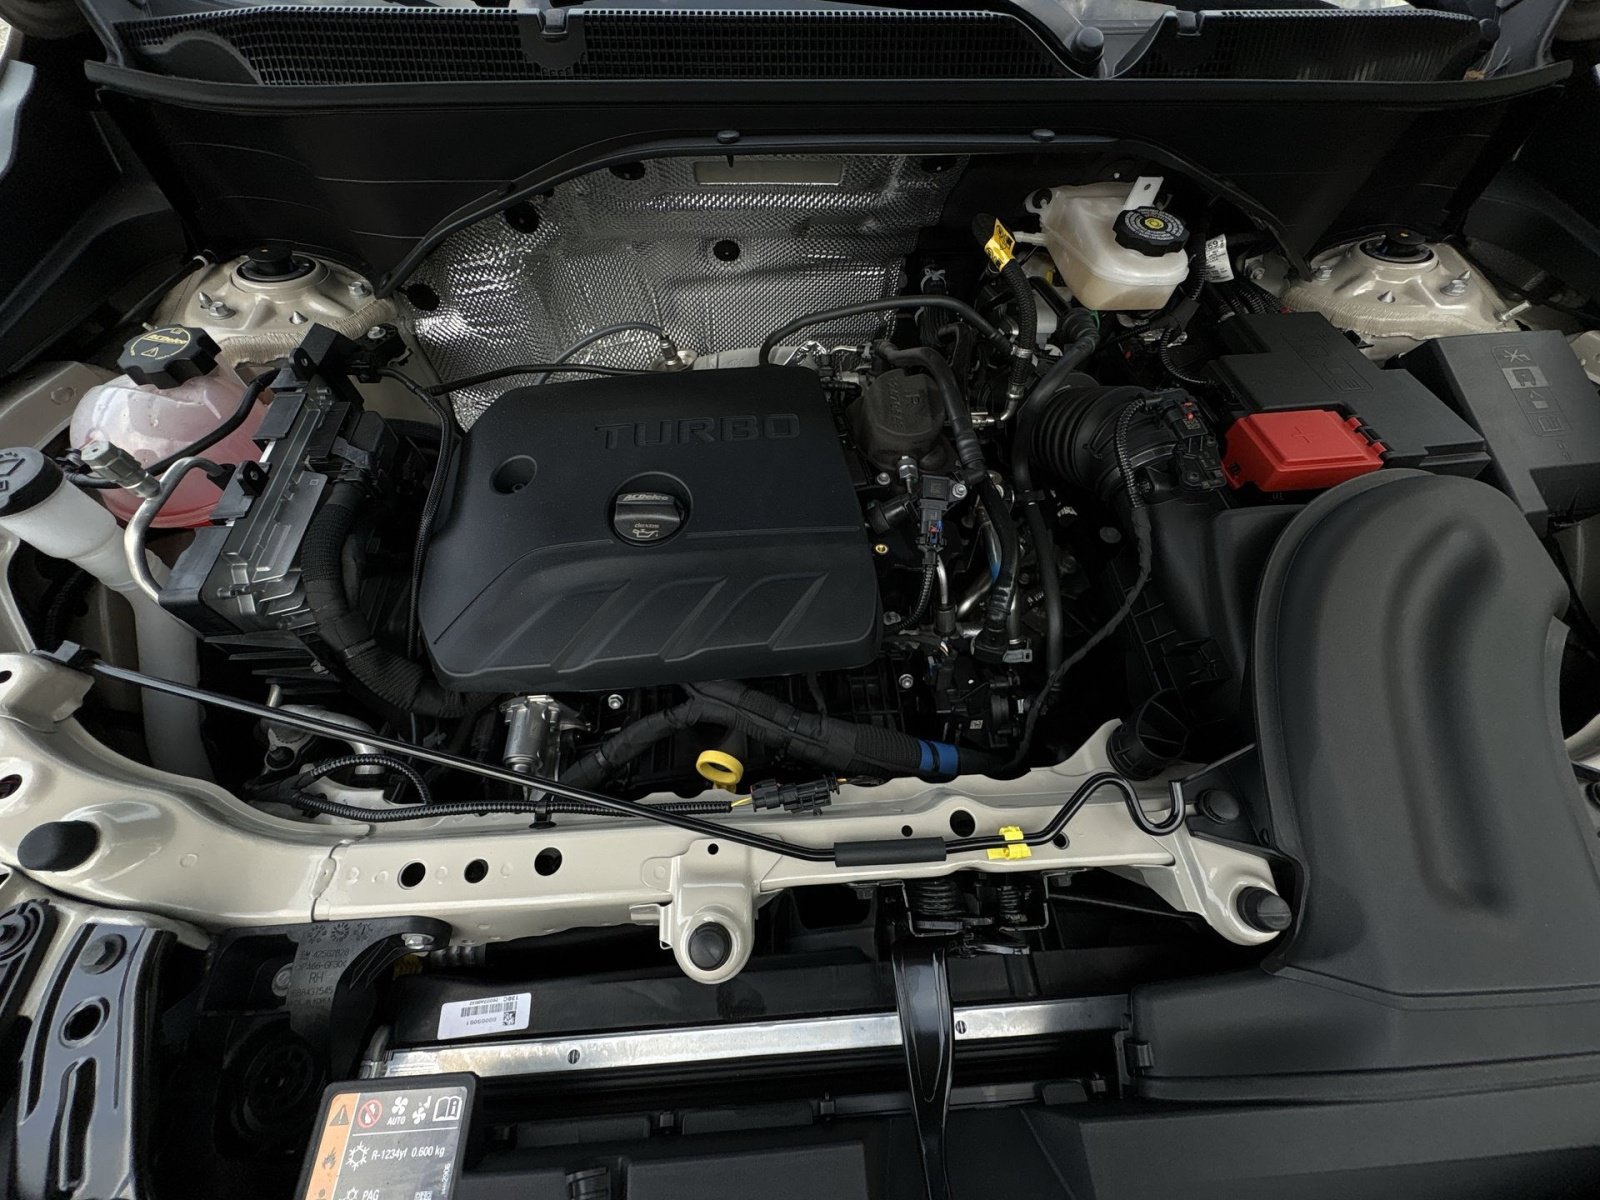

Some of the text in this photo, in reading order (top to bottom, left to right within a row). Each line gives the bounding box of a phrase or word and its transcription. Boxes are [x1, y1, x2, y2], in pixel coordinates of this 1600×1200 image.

[594, 413, 801, 450] TURBO
[622, 493, 670, 502] ACDelco
[308, 972, 325, 984] RH
[386, 1115, 407, 1126] AUTO
[371, 1145, 446, 1162] R-1234yf 0.600 kg
[361, 1188, 380, 1200] PAG
